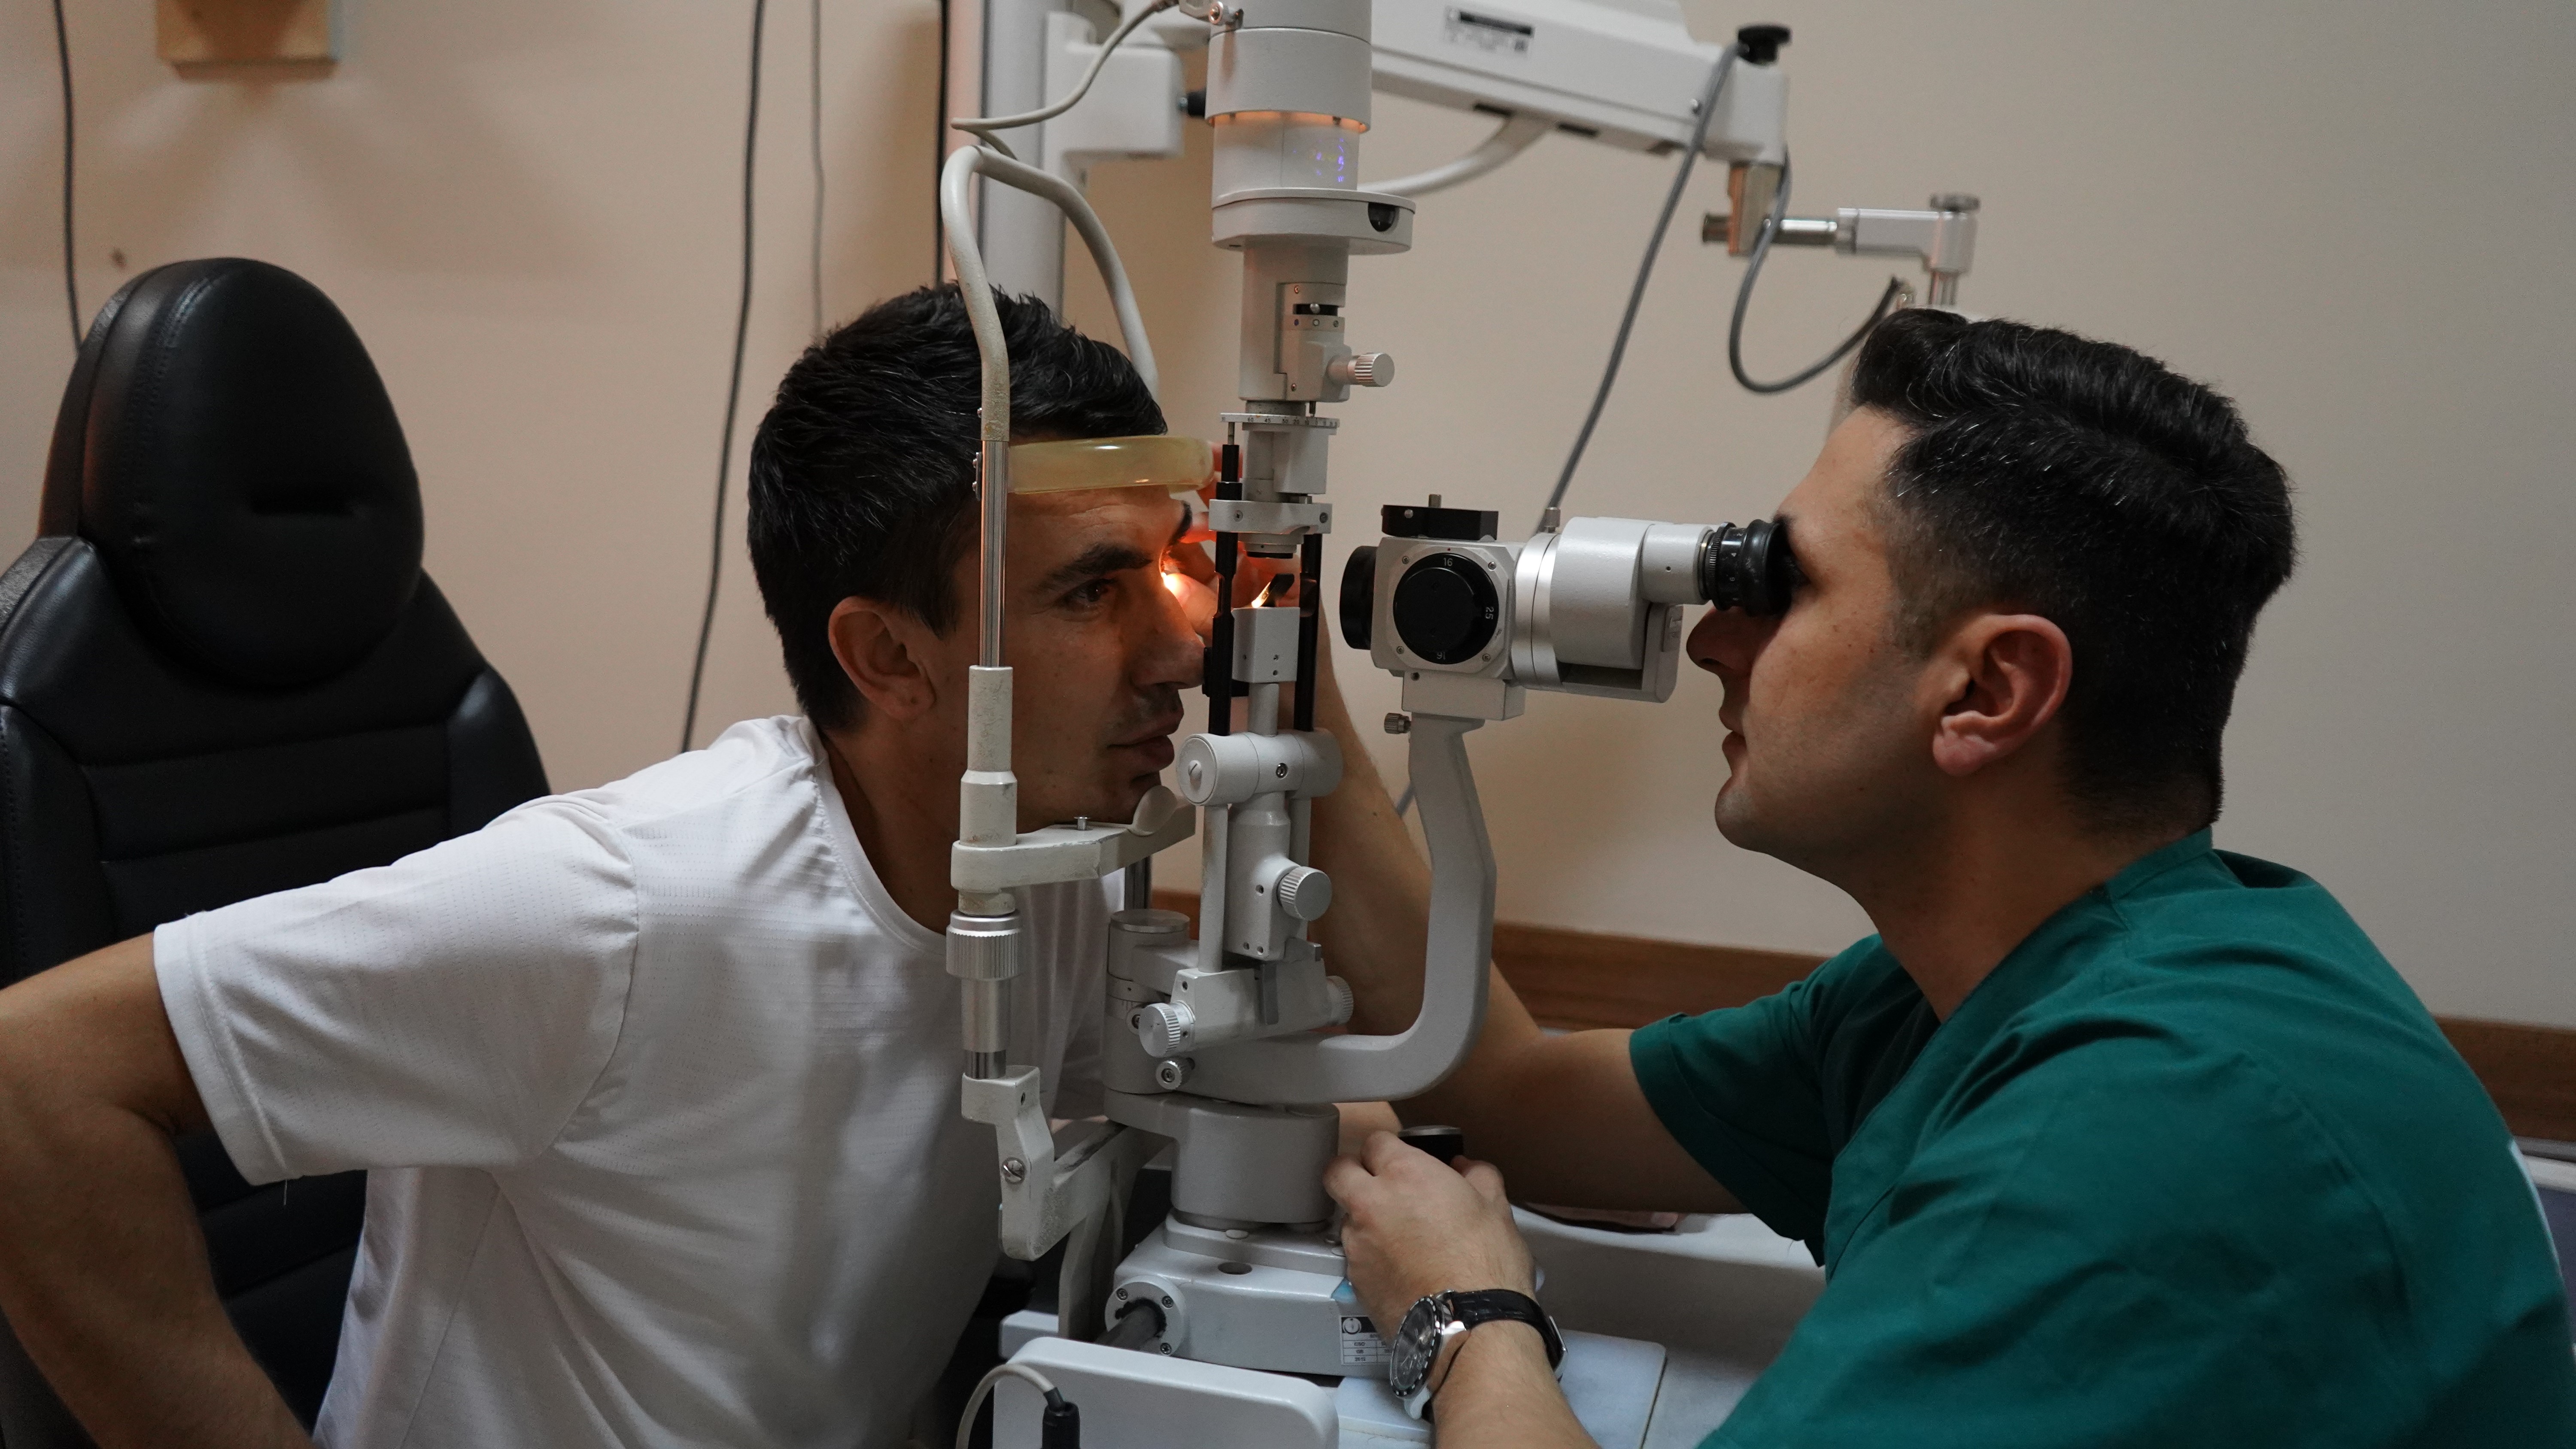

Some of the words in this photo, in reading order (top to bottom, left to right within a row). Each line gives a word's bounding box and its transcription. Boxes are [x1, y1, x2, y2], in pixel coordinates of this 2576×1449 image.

[1443, 558, 1453, 567] 16
[1485, 606, 1494, 620] 25
[1437, 652, 1446, 660] 16
